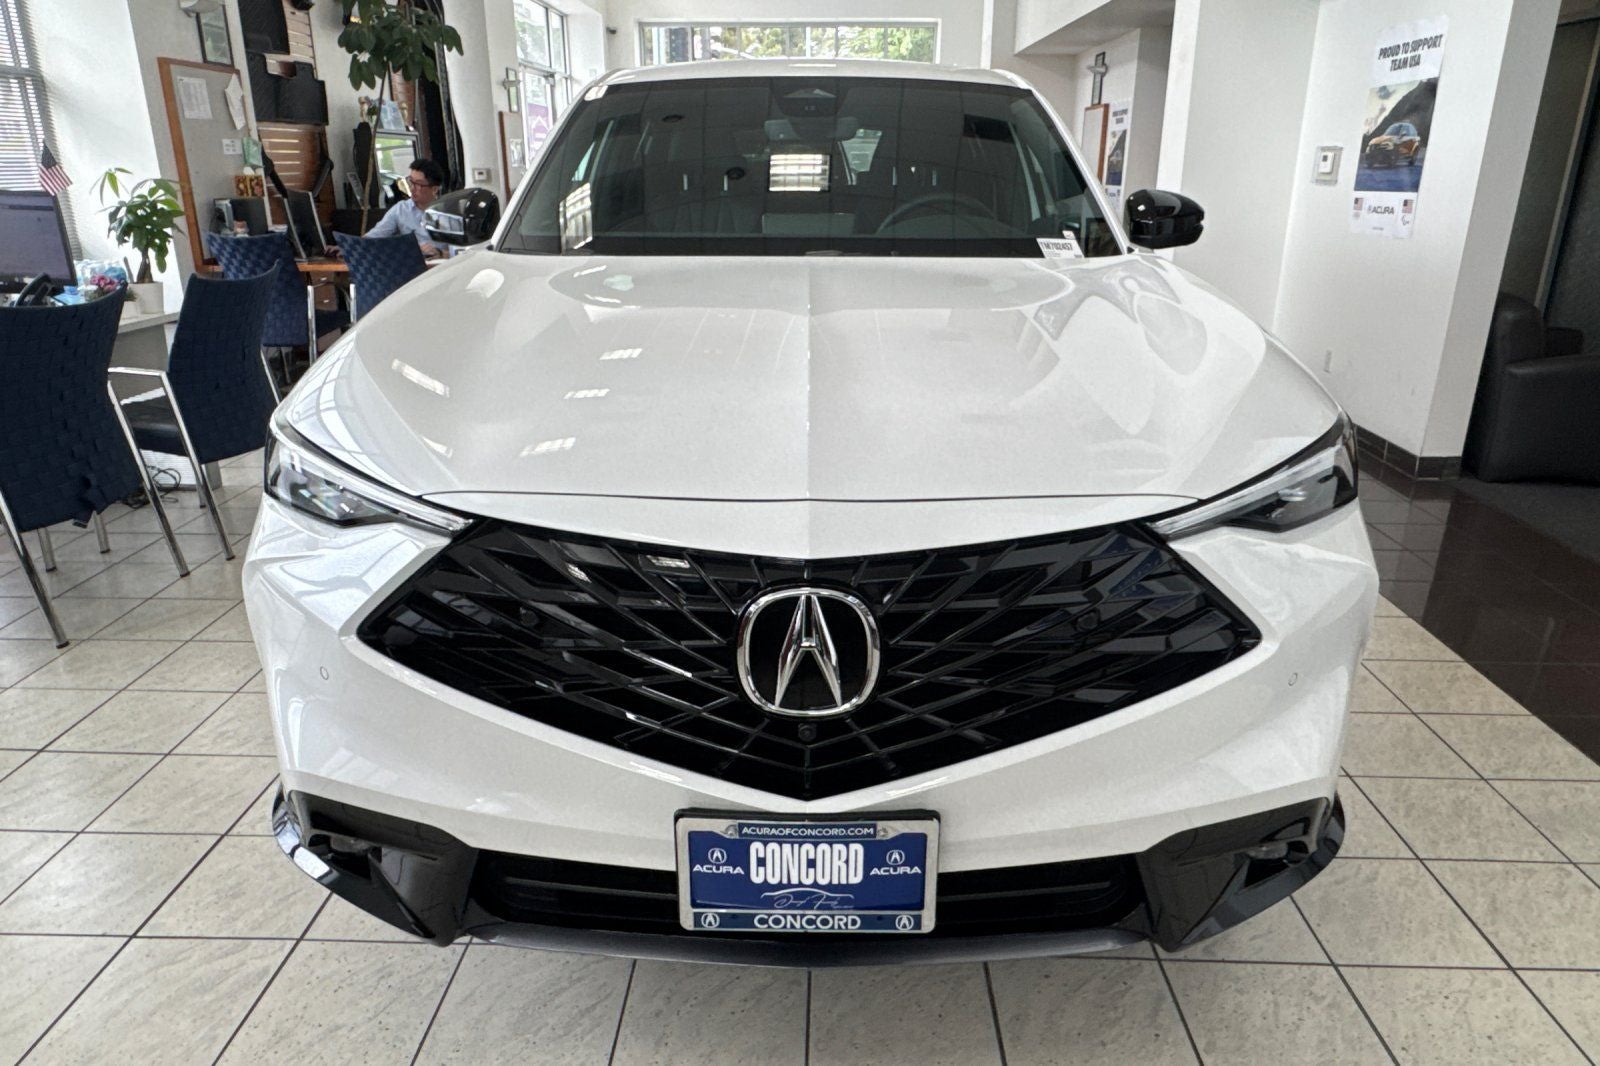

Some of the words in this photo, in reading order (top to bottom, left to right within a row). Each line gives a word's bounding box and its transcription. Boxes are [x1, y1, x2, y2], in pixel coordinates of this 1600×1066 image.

[1378, 44, 1400, 60] PROUD
[1401, 41, 1410, 54] TO
[1409, 34, 1443, 53] SUPPORT
[1390, 57, 1408, 72] TEAM
[1409, 53, 1421, 68] USA
[1372, 205, 1394, 214] ACURA
[742, 826, 874, 837] ACURAOFCONCORD.COM
[692, 864, 744, 875] ACURA
[749, 841, 864, 885] CONCORD
[869, 866, 921, 876] ACURA
[754, 914, 861, 930] CONCORD
